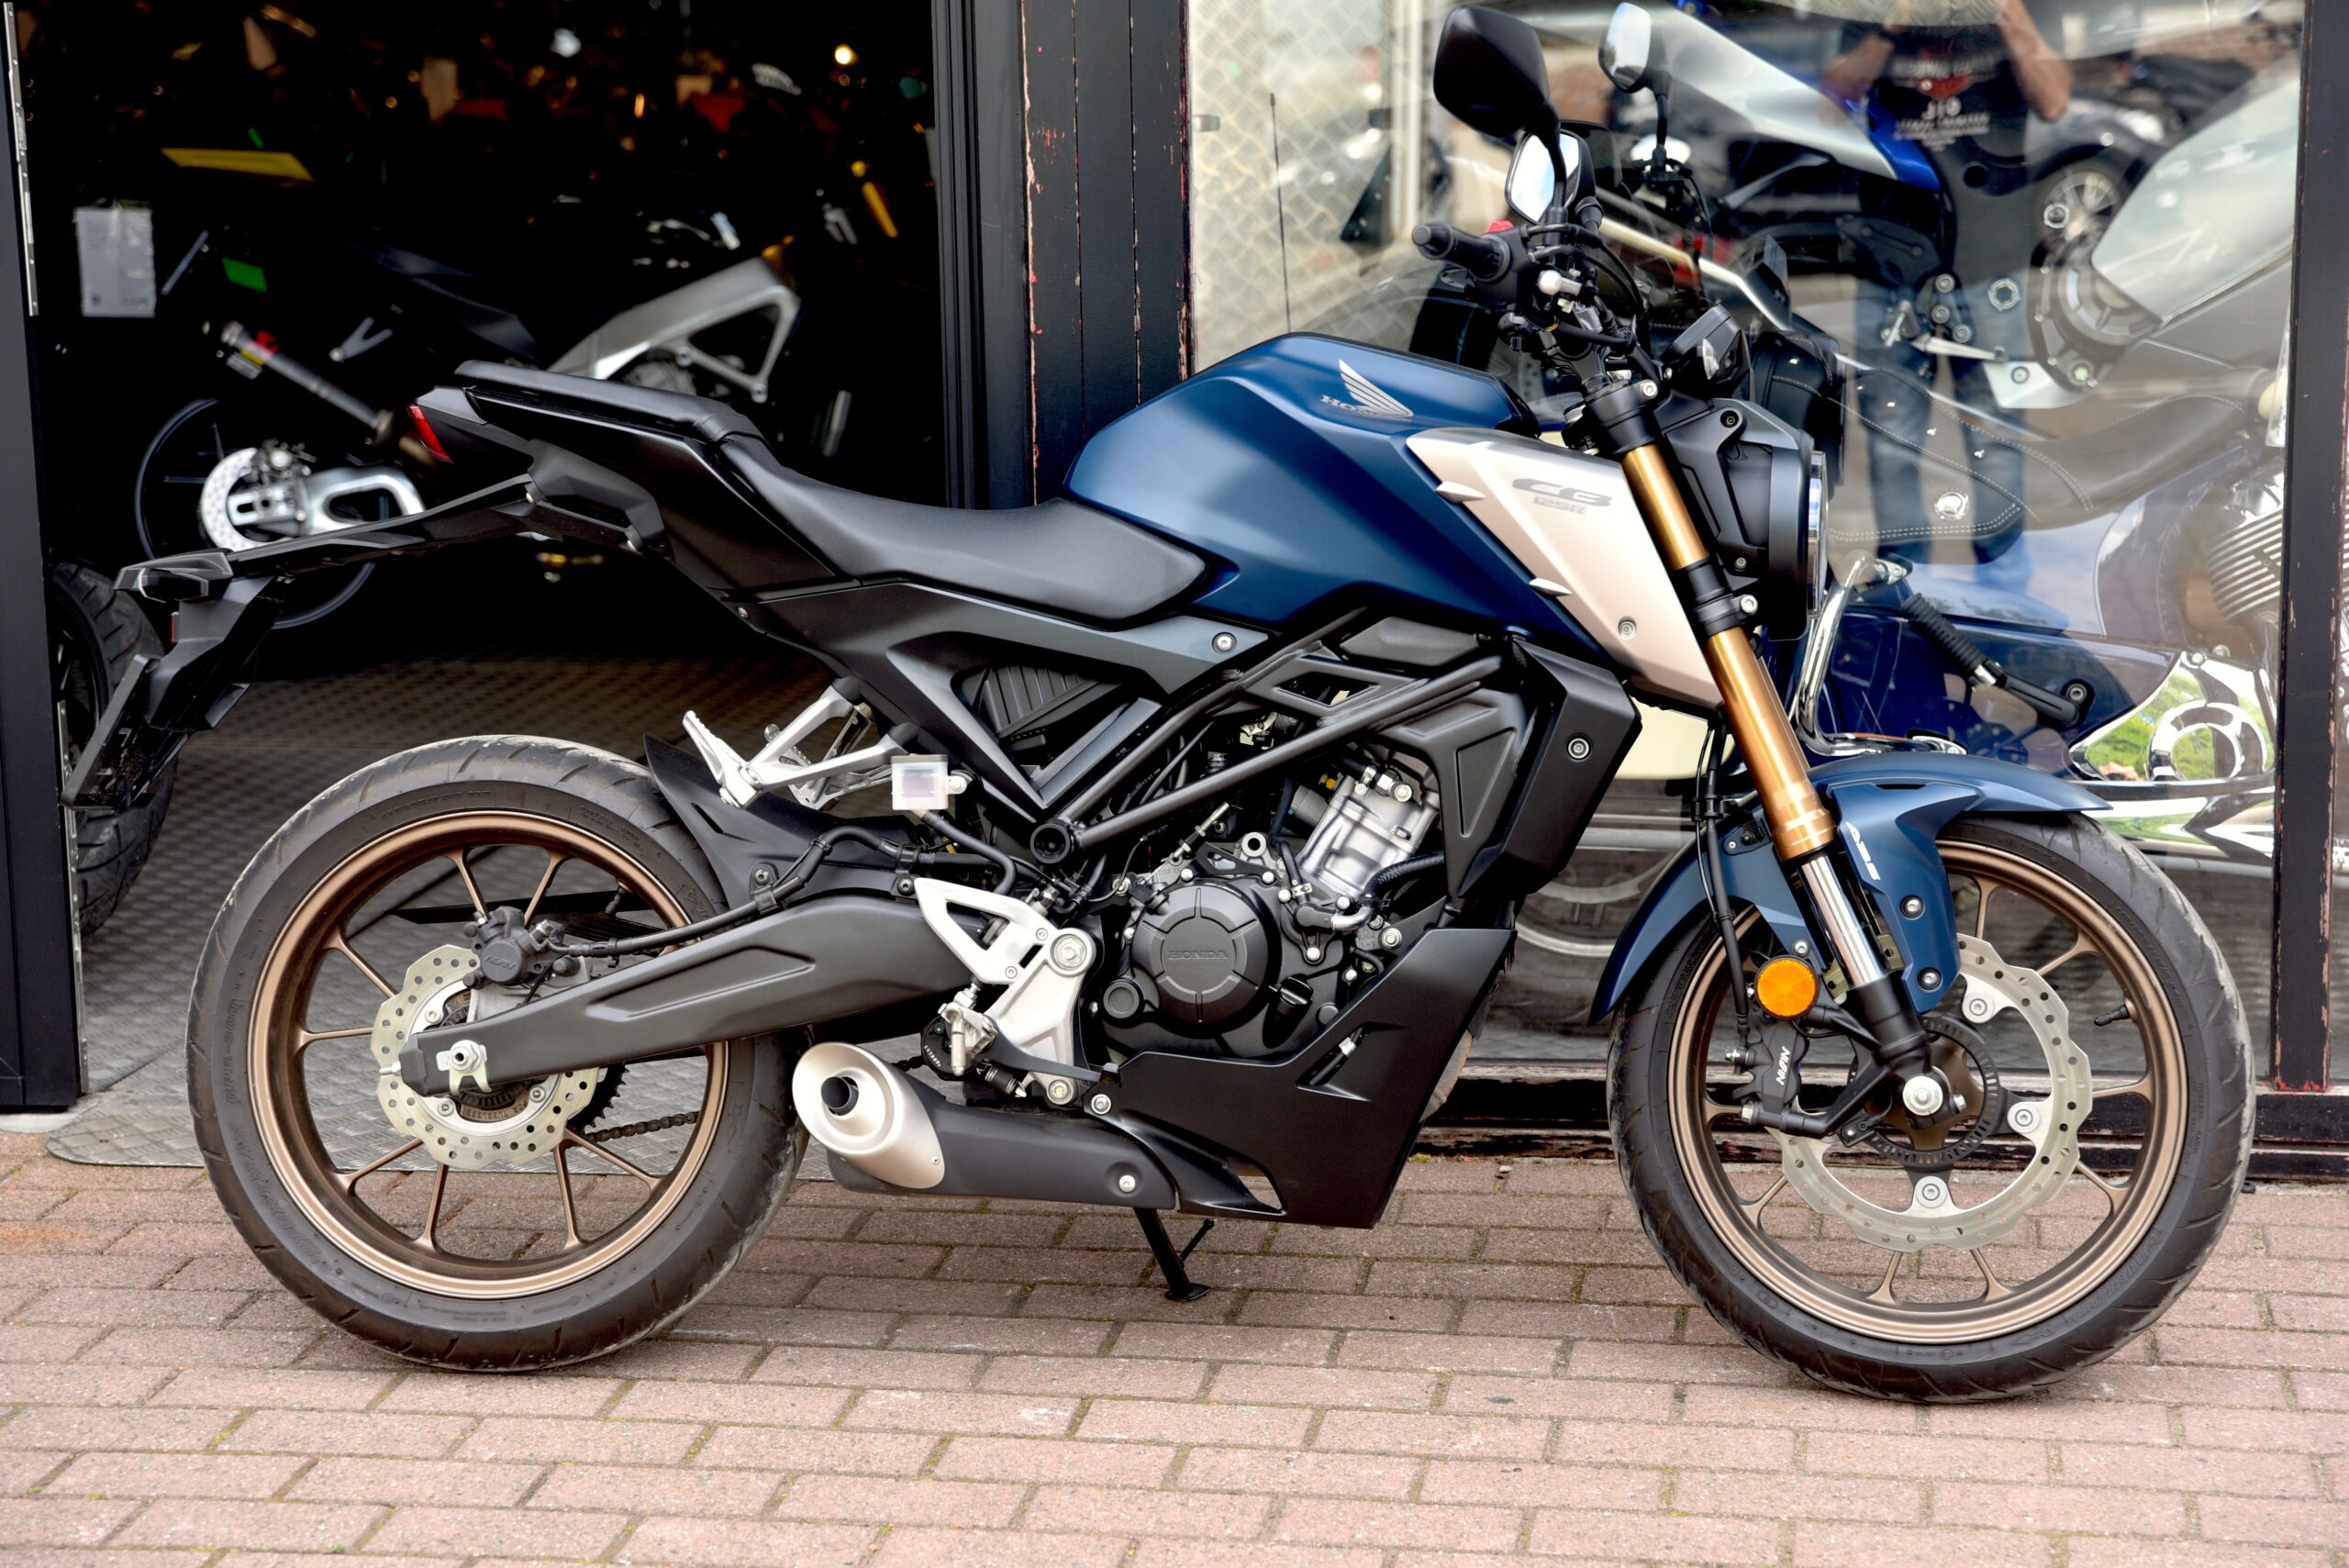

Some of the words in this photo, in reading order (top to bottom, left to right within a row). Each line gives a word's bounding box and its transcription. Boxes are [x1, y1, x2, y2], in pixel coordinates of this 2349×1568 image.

[1512, 478, 1612, 506] CB
[1533, 496, 1586, 515] 125R
[1845, 821, 1881, 881] ABS
[1167, 950, 1229, 960] HONDA
